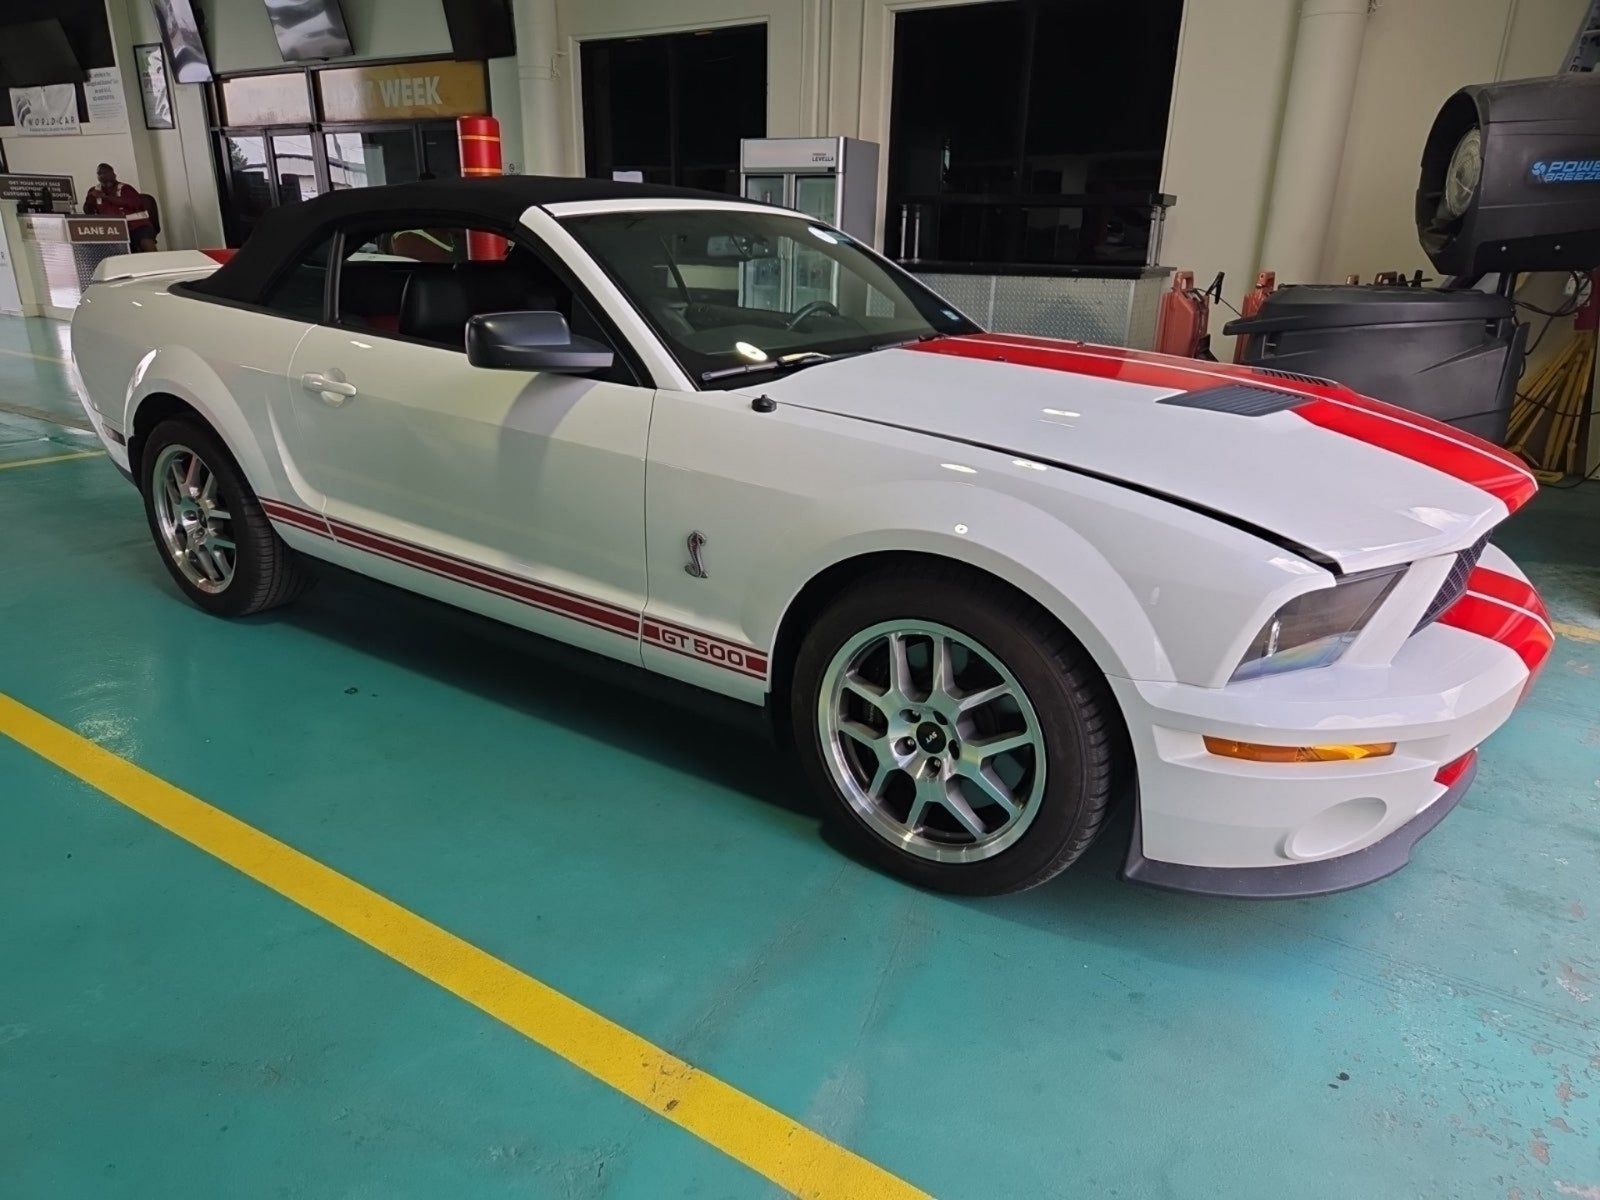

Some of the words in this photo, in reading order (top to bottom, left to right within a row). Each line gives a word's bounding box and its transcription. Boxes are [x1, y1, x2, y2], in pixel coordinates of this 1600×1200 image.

[379, 75, 443, 108] WEEK
[28, 116, 56, 126] WORLD
[59, 115, 75, 125] CAR
[77, 226, 105, 236] LANE
[107, 226, 120, 235] AL
[661, 628, 690, 649] GT
[693, 639, 744, 667] 500
